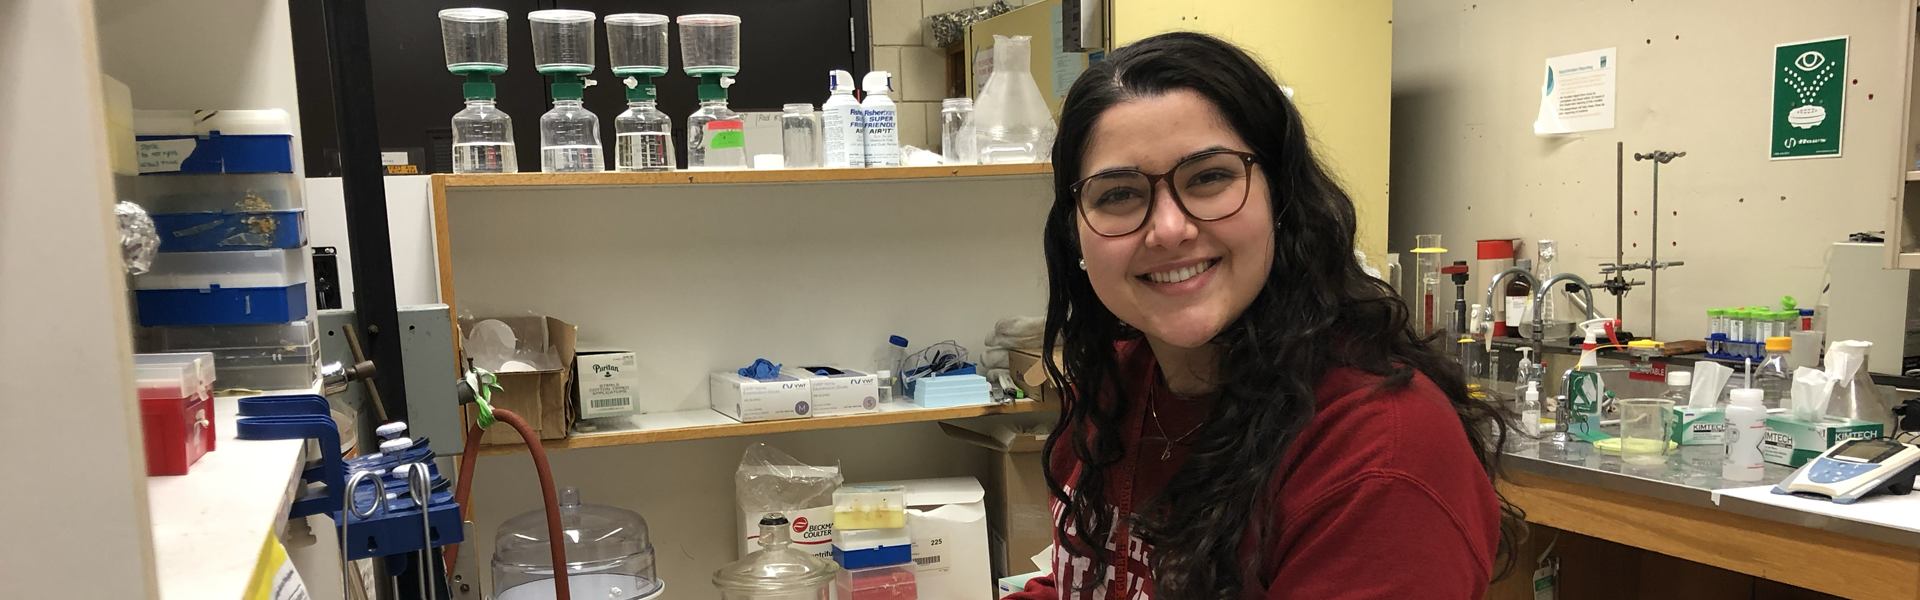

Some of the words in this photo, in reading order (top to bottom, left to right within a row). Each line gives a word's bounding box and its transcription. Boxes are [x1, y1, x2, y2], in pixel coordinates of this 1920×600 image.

[592, 363, 619, 374] Puritan
[798, 404, 806, 412] M
[1764, 431, 1793, 444] IMTECH
[1835, 430, 1878, 441] KIMTECH
[803, 529, 832, 539] COULTER
[930, 538, 943, 546] 225
[1115, 543, 1126, 591] GUELPH
